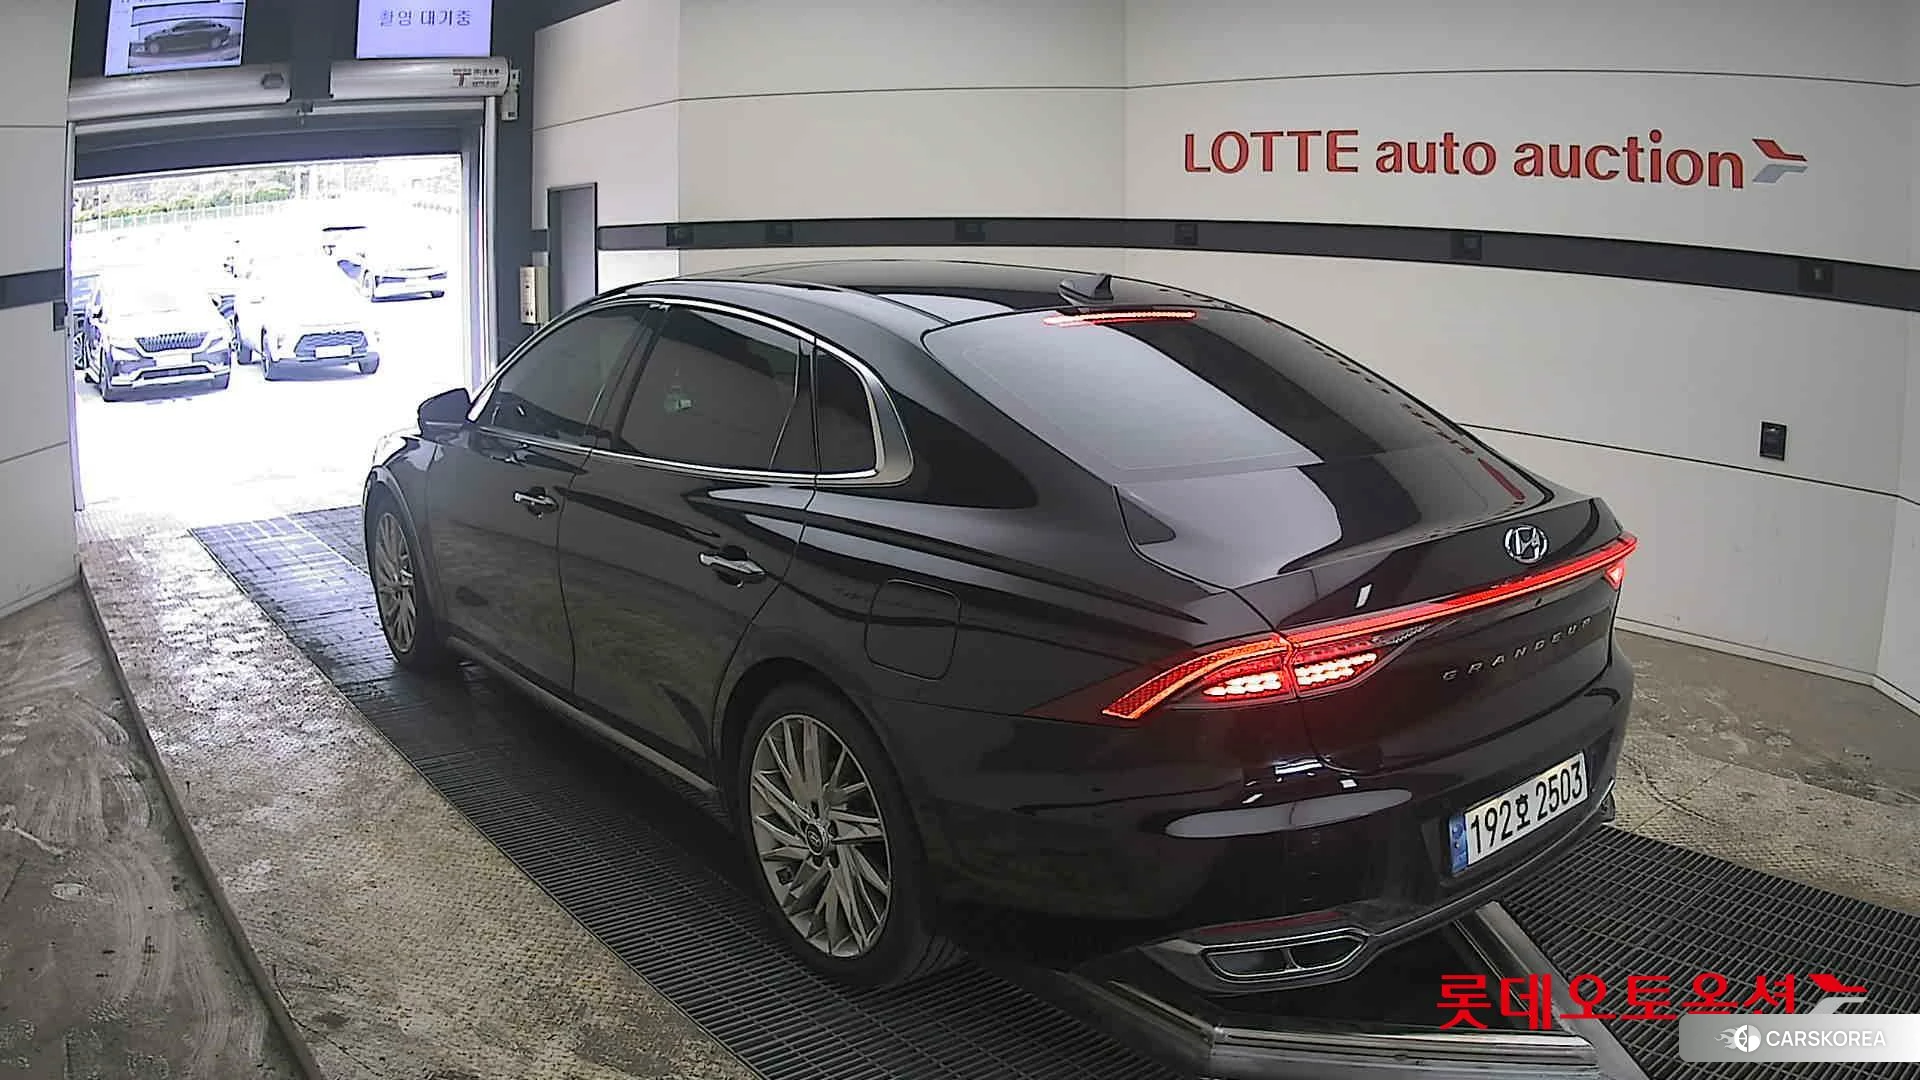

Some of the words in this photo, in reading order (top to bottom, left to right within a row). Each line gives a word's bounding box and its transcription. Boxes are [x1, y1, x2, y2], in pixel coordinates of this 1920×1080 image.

[421, 9, 470, 26] 대기중
[1185, 130, 1359, 174] LOTTE
[1375, 132, 1497, 176] auto
[1513, 129, 1744, 189] auction
[1442, 616, 1592, 681] GRANDEUR
[1470, 793, 1531, 855] 192호
[1535, 761, 1583, 822] 2503
